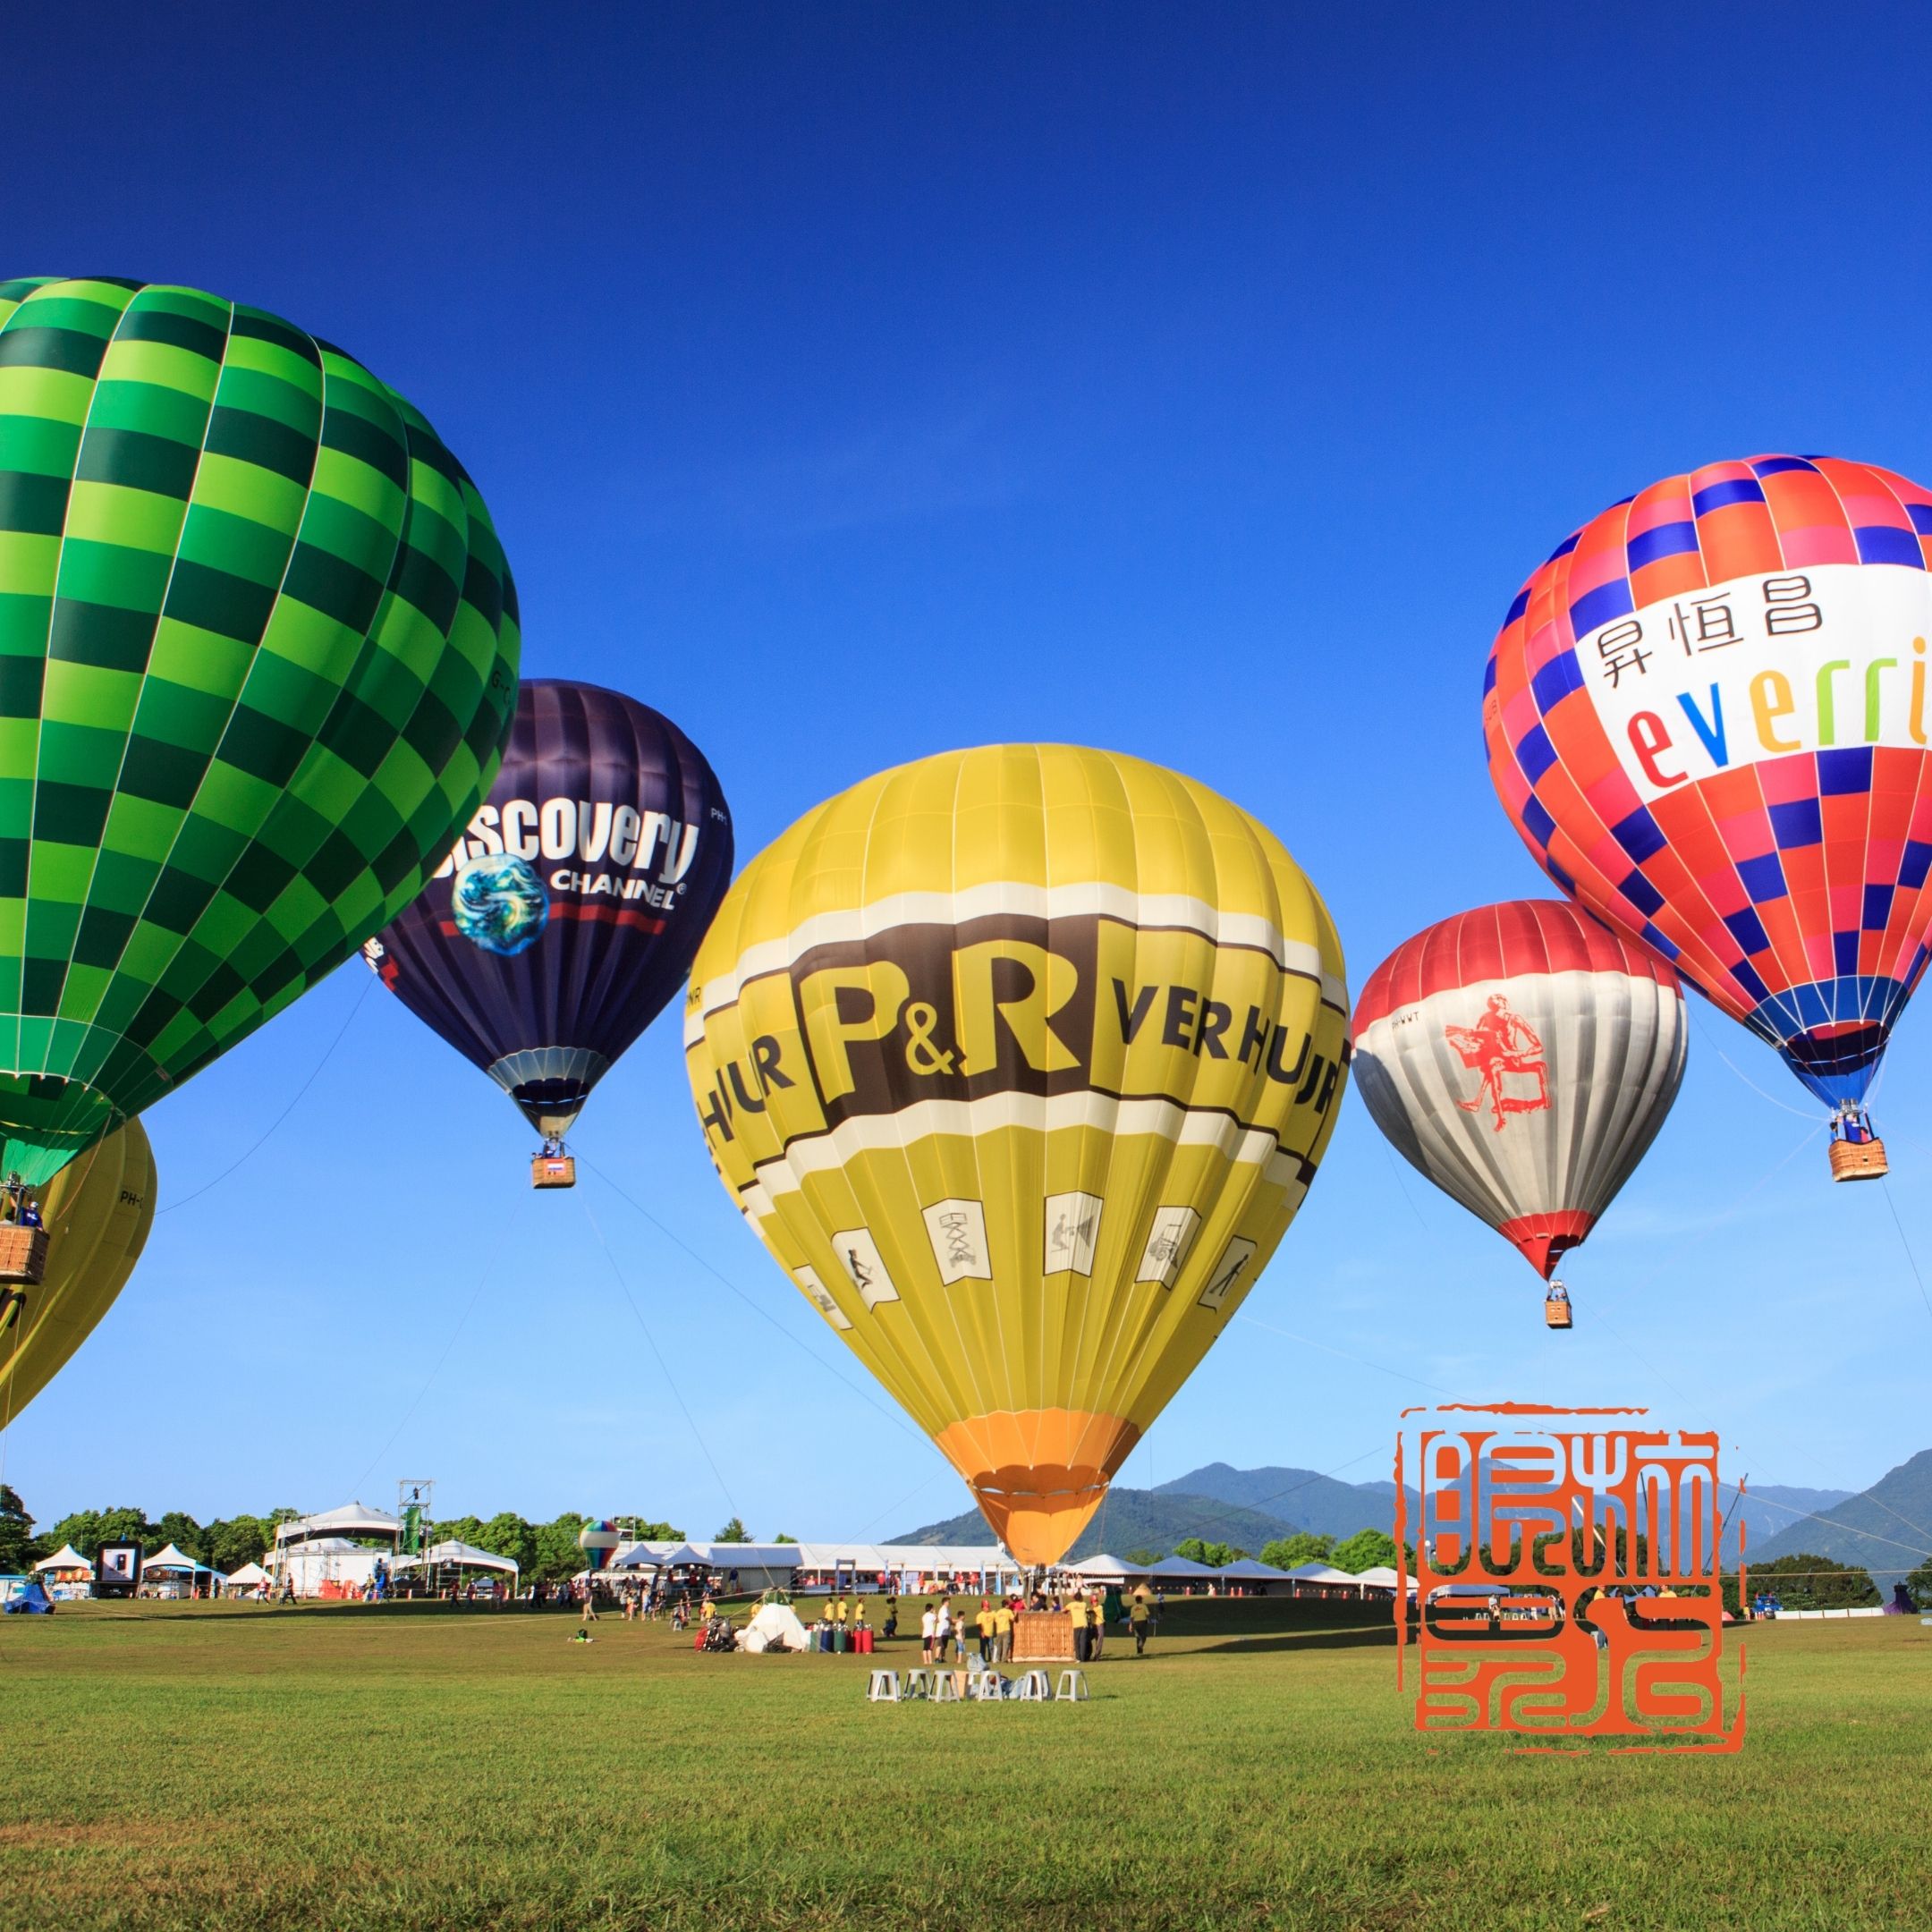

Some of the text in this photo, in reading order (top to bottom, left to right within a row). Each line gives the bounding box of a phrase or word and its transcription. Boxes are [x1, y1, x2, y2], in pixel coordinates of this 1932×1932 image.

[1627, 636, 1928, 788] everri
[550, 869, 675, 911] CHANNEL
[800, 939, 1081, 1105] P&R
